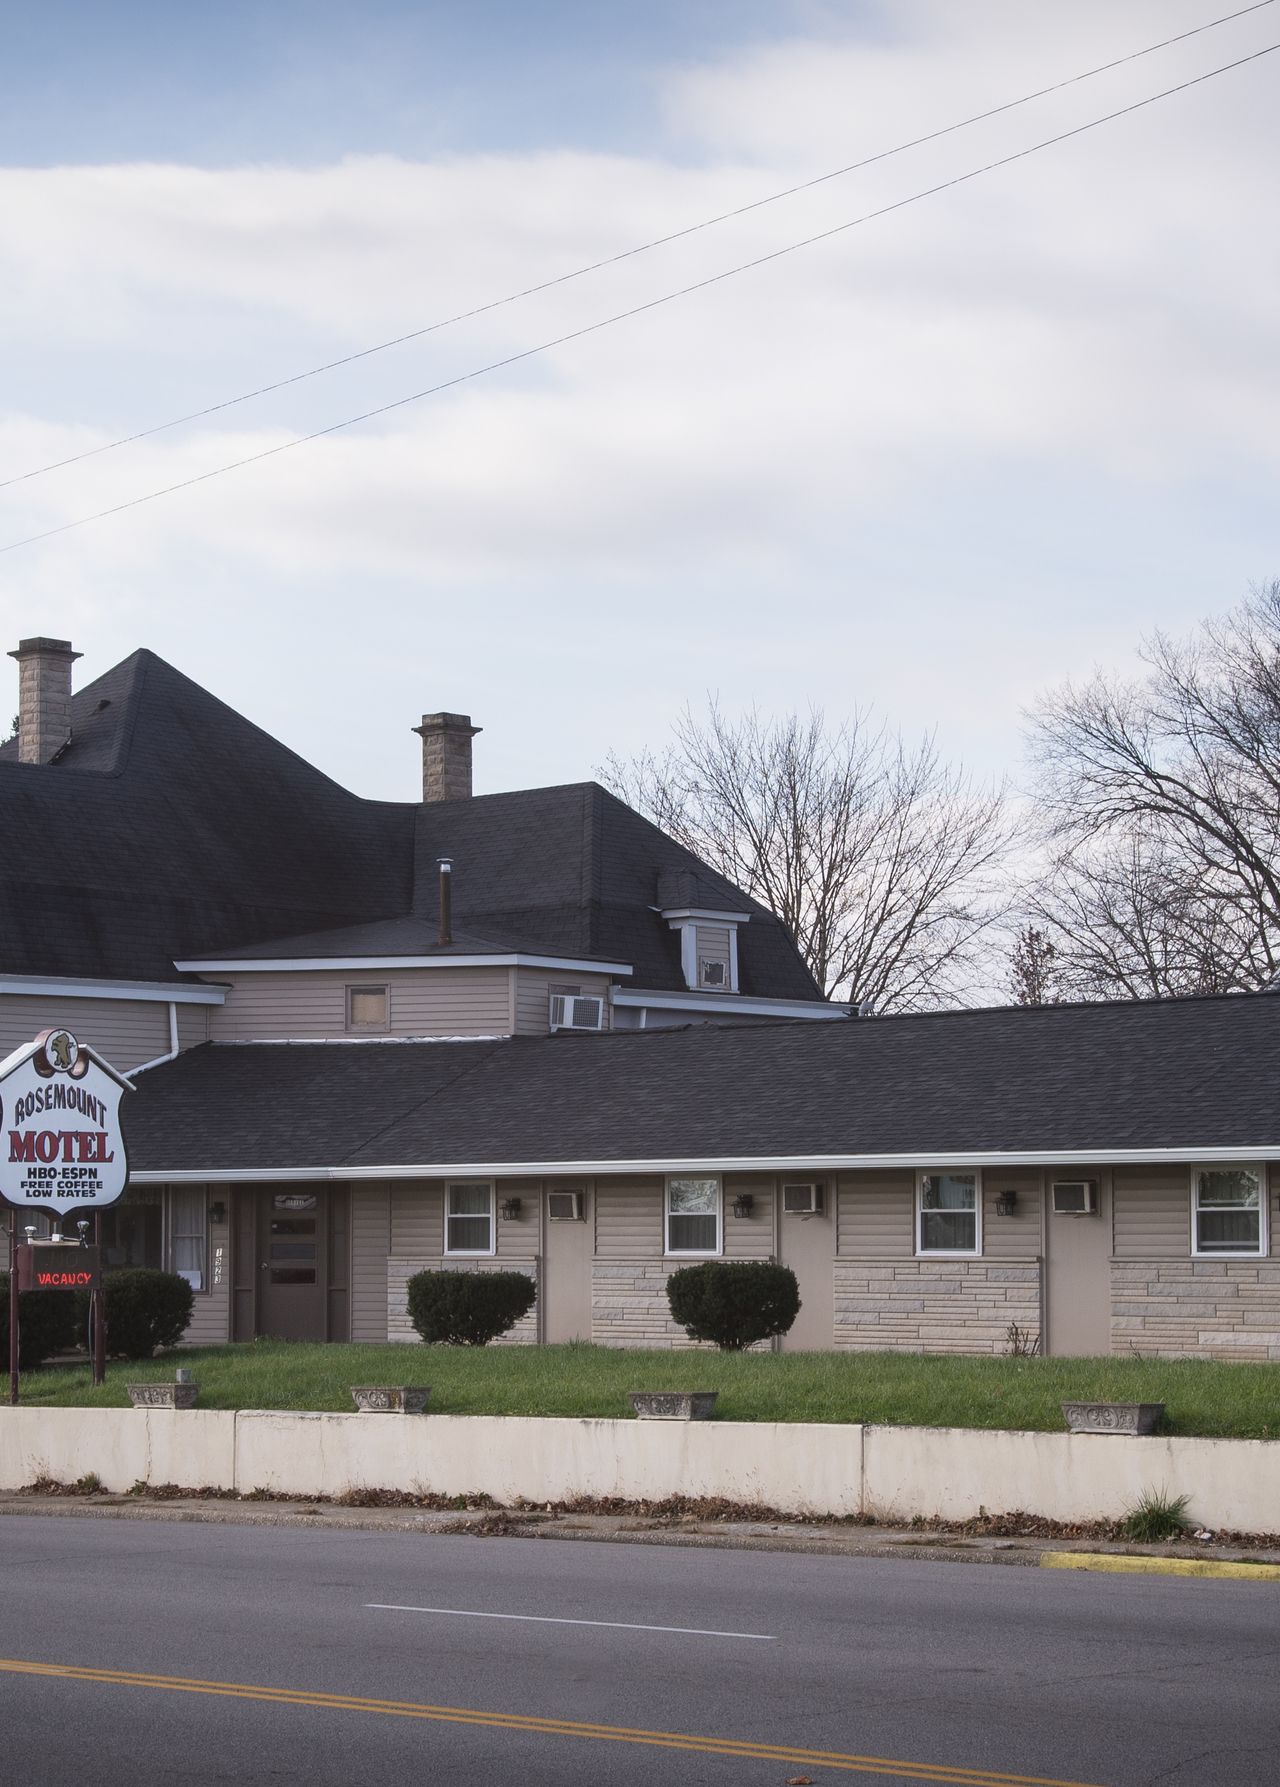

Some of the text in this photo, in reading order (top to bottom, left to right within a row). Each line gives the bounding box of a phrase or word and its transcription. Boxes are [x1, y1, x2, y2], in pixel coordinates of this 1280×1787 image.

[15, 1084, 107, 1129] ROSEMOUNT
[8, 1130, 115, 1163] MOTEL
[20, 1181, 103, 1189] FREE COFFEE
[26, 1189, 96, 1198] LOW RATES
[37, 1272, 92, 1285] VACANCY
